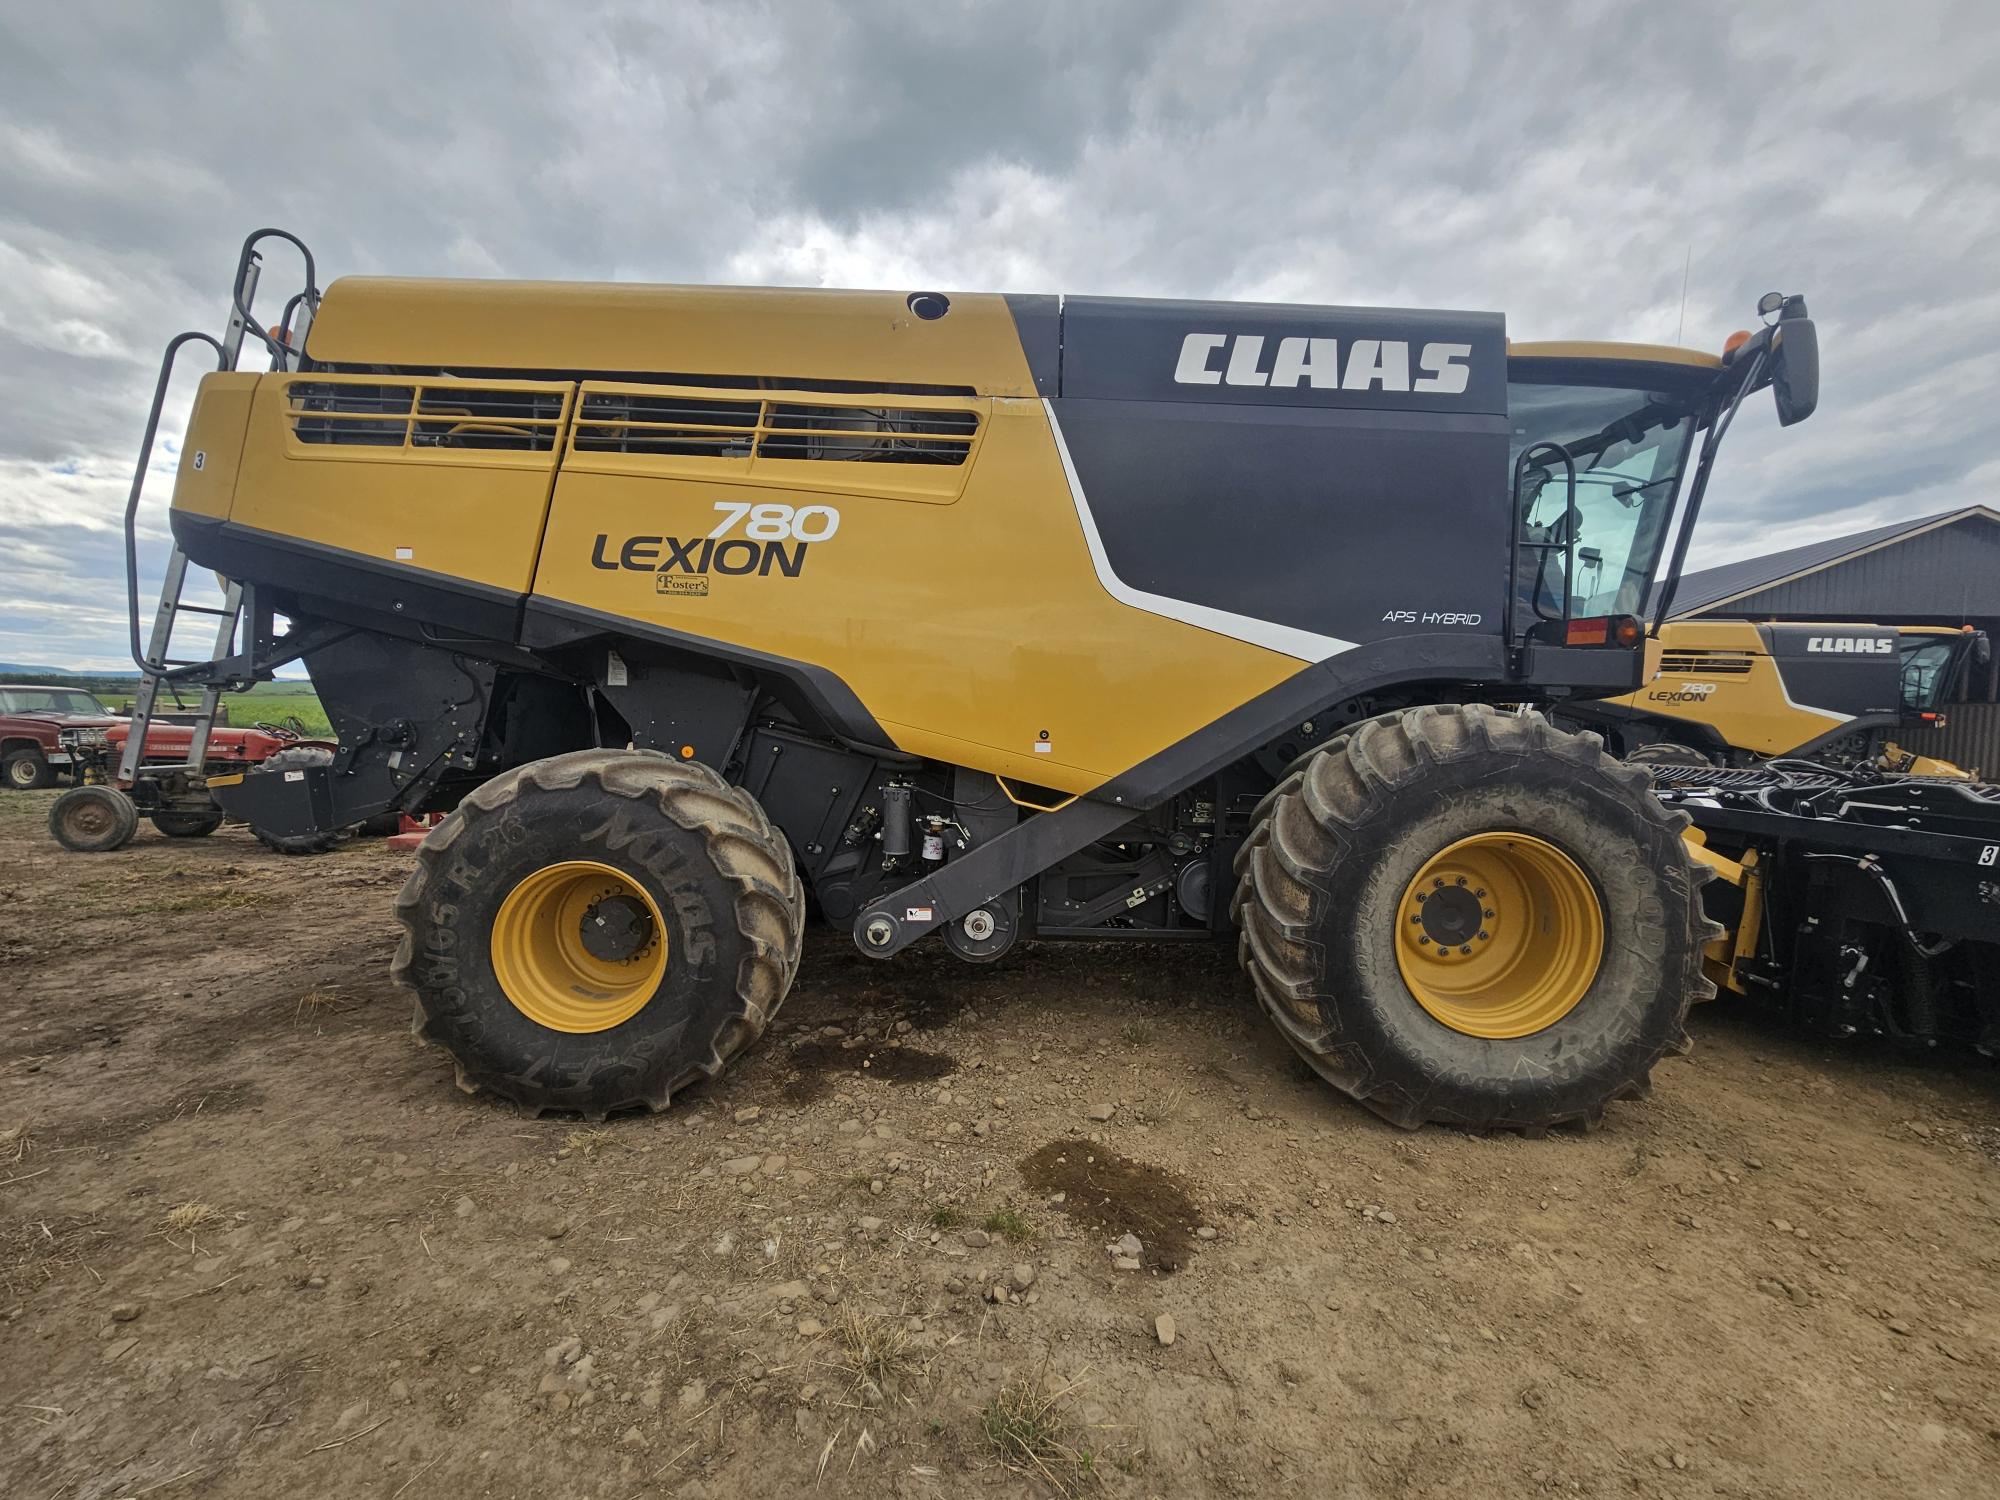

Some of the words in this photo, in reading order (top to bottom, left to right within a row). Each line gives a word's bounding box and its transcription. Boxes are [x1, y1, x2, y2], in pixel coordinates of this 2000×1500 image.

[1174, 333, 1472, 394] CLAAS
[196, 452, 204, 469] 3
[707, 502, 840, 542] 780
[591, 534, 808, 577] LEXION
[1382, 610, 1417, 623] APS
[1421, 612, 1482, 625] HYBRID
[1807, 637, 1893, 653] CLAAS
[1680, 682, 1716, 693] 780
[1648, 691, 1707, 702] LEXION
[1983, 847, 1994, 863] 3
